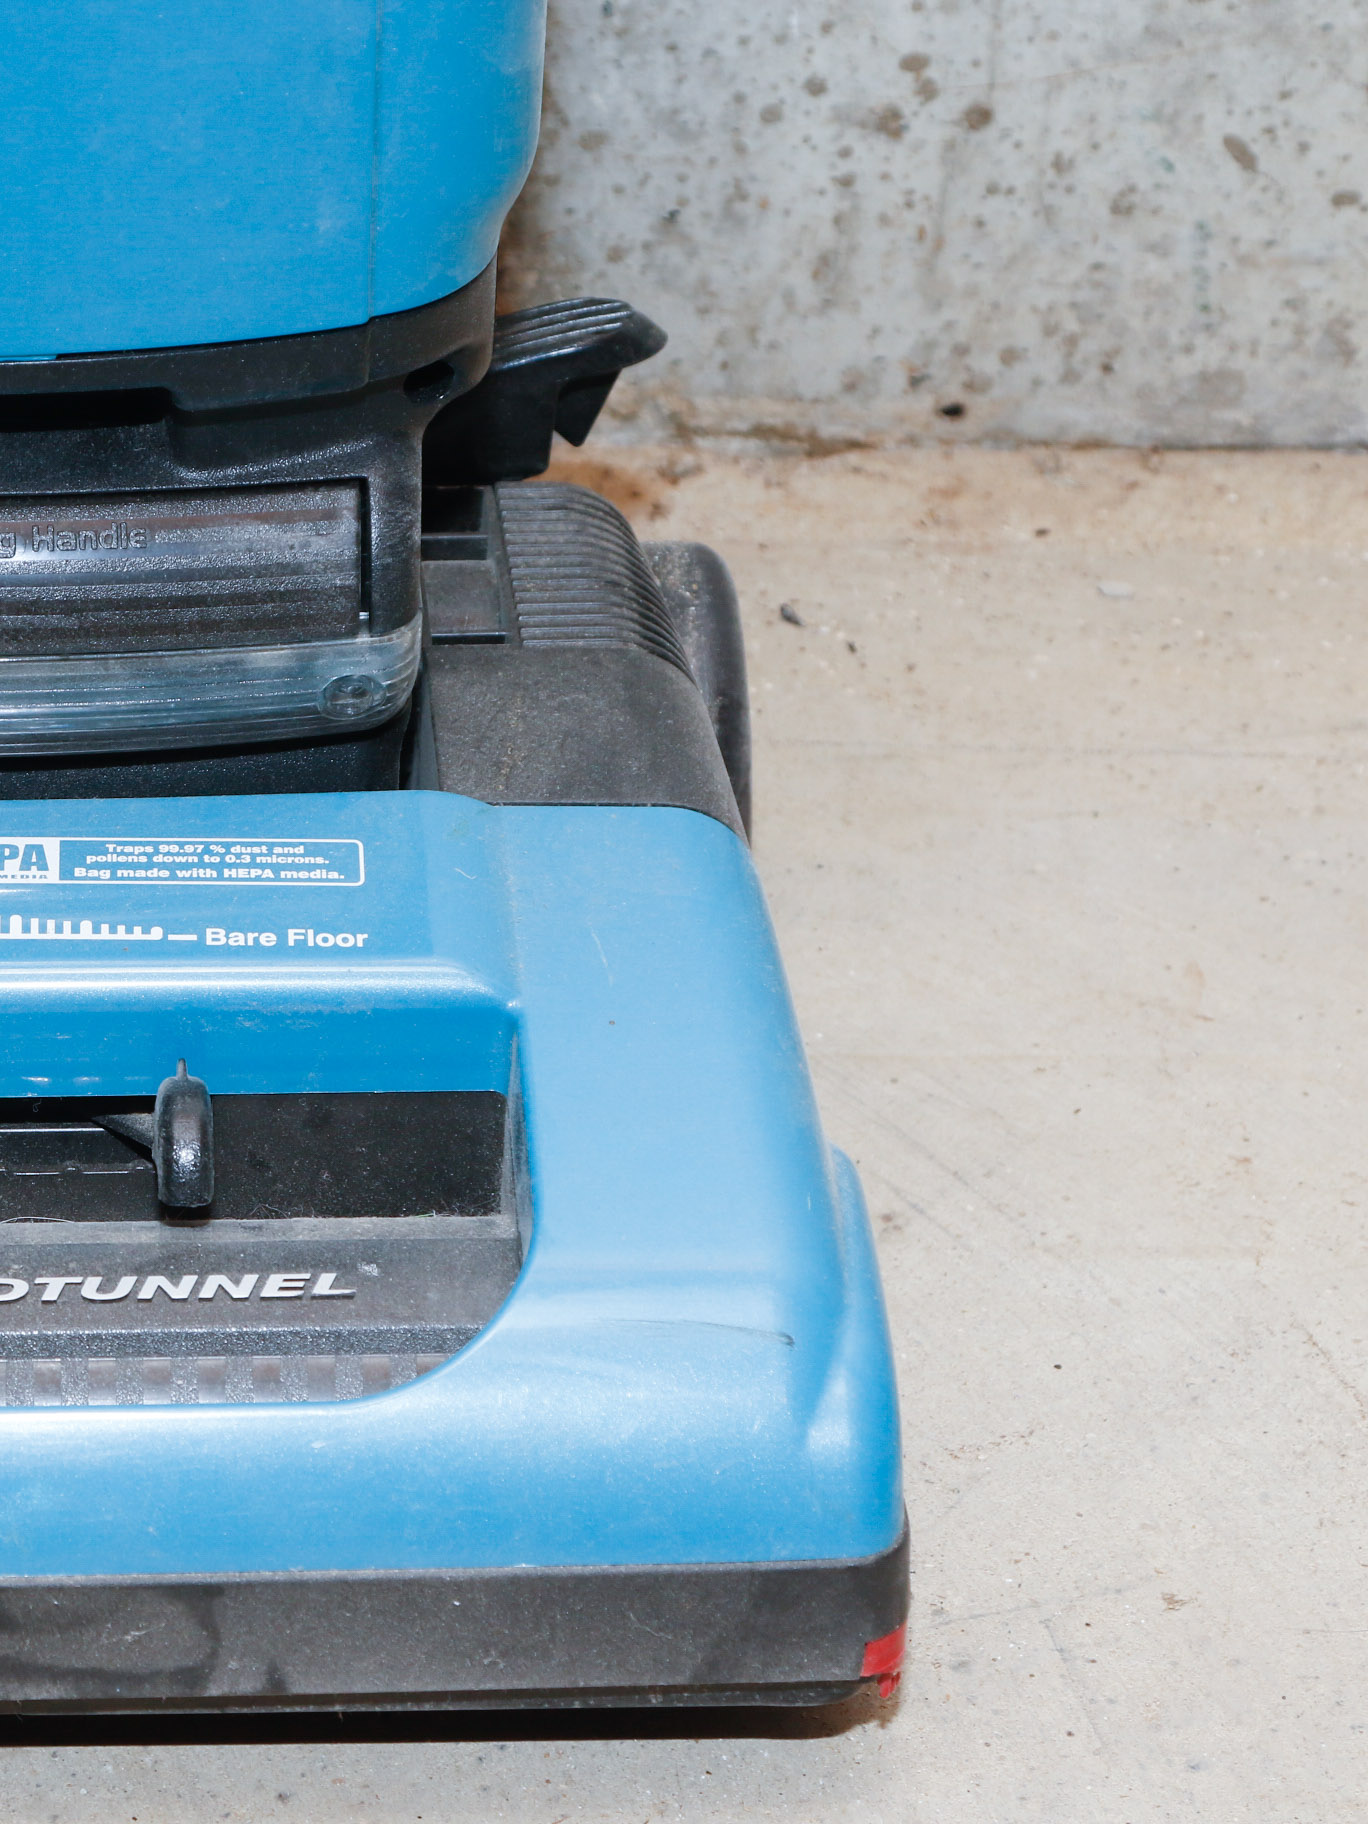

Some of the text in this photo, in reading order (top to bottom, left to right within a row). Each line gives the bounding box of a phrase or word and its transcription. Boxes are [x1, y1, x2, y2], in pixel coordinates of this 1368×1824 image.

[32, 521, 148, 552] Handle
[105, 843, 154, 855] Traps
[158, 844, 205, 854] 99.97
[230, 844, 269, 855] dust
[272, 844, 305, 855] and
[86, 854, 330, 864] pollens down to 0.3 microns.
[73, 867, 345, 880] Bag made with HEPA media.
[205, 928, 369, 948] Bare Floor
